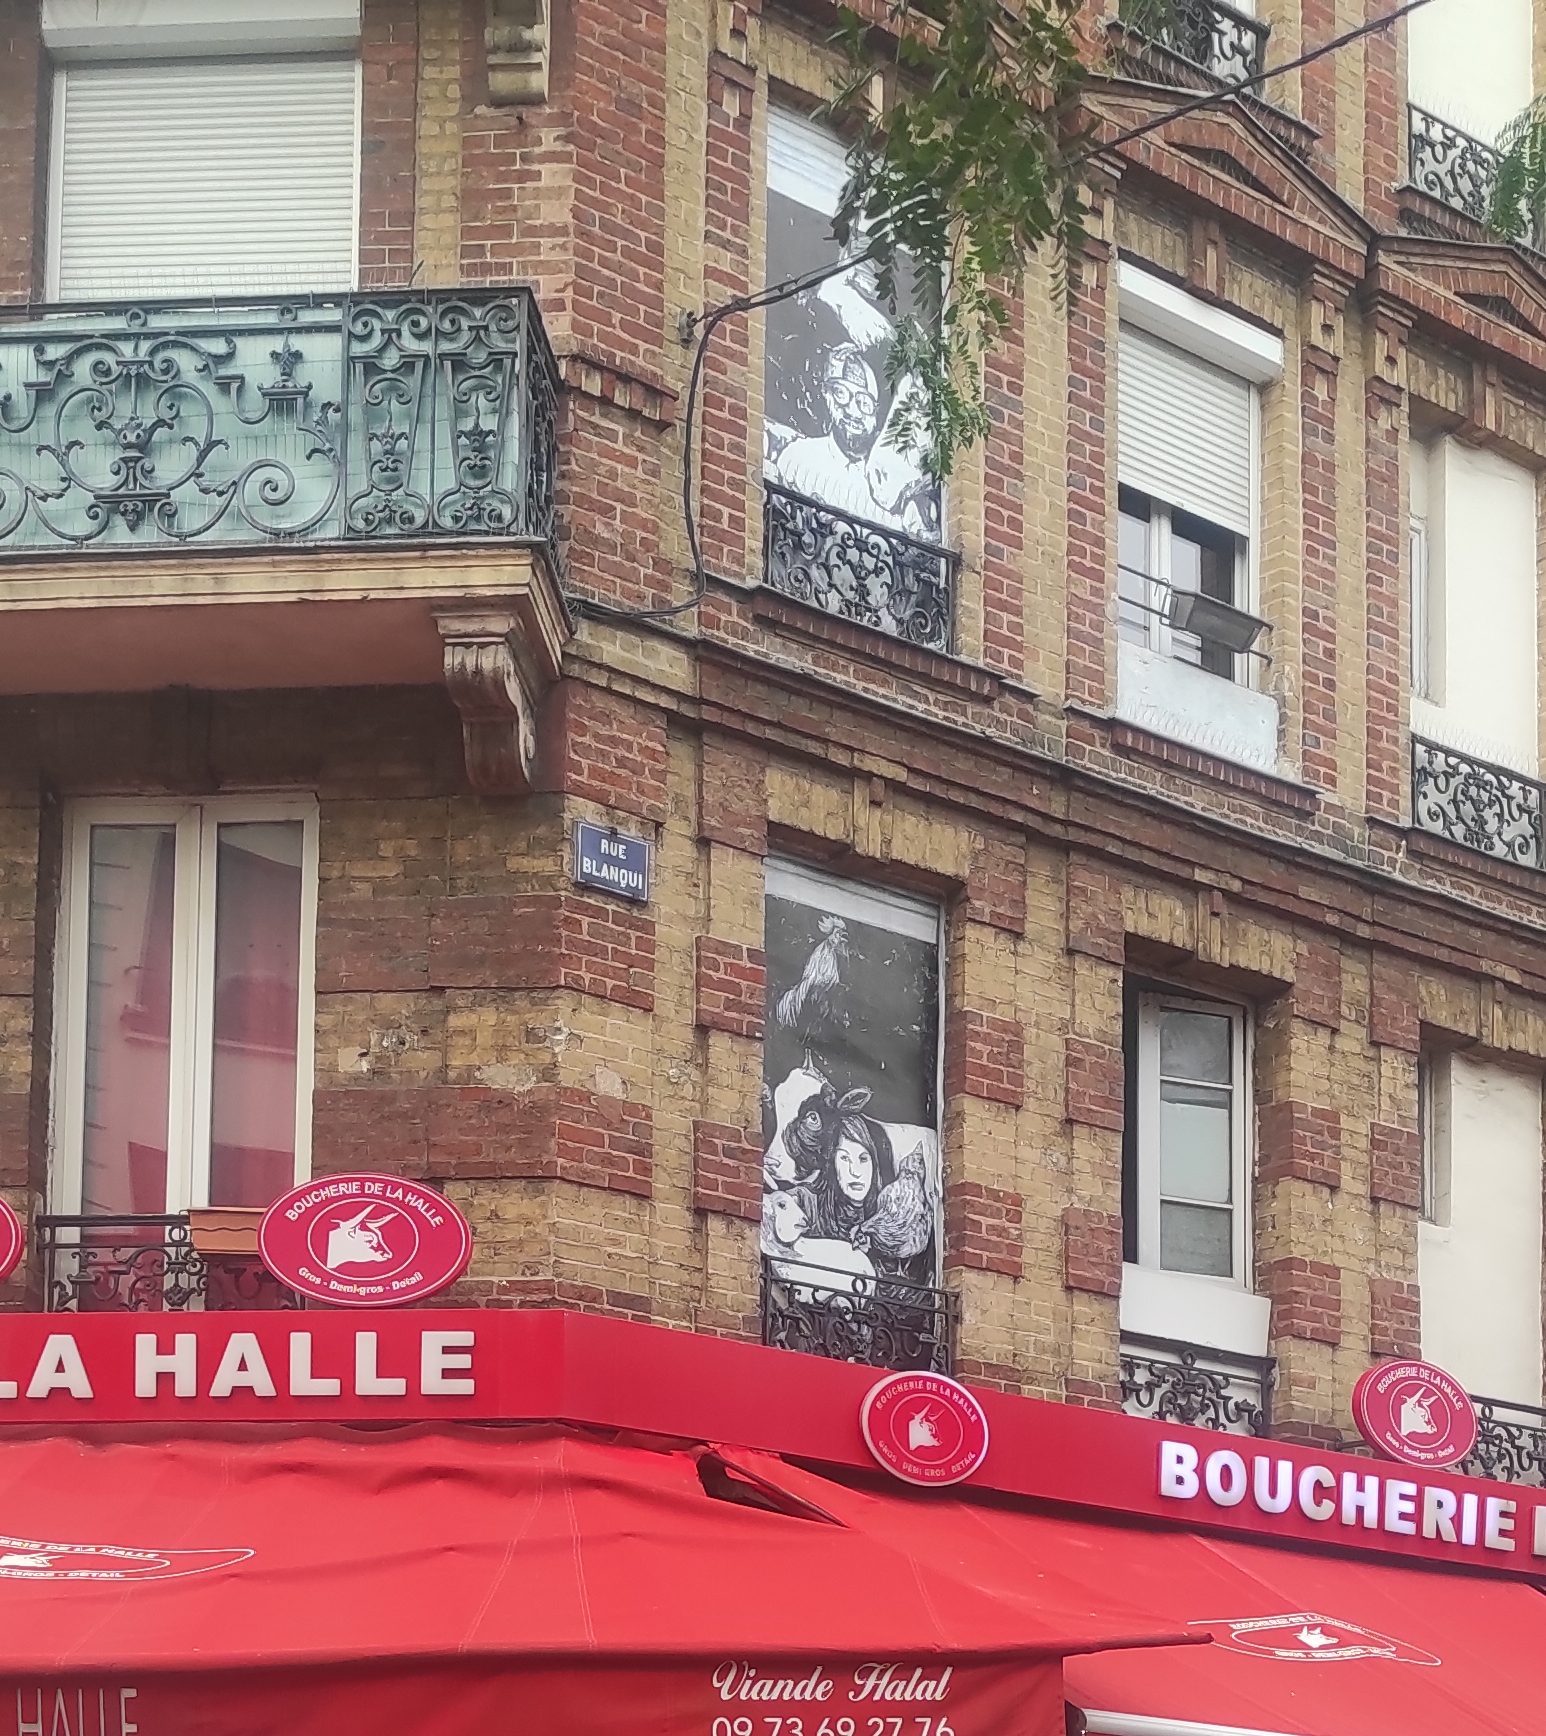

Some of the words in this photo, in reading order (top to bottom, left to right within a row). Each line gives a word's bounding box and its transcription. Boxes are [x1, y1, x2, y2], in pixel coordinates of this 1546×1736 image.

[600, 838, 627, 860] RUE
[582, 855, 643, 890] BLANQUI
[284, 1181, 362, 1222] BOUCHERIE
[364, 1182, 383, 1196] DE
[385, 1185, 404, 1202] LA
[404, 1192, 446, 1230] HALLE
[298, 1267, 322, 1285] Gros
[134, 1330, 477, 1399] HALLE
[876, 1379, 924, 1411] BOUCHERIE
[926, 1381, 937, 1392] DE
[939, 1386, 951, 1397] LA
[952, 1392, 978, 1425] HALLE
[1376, 1366, 1418, 1394] BOUCHERIE
[1419, 1368, 1430, 1381] DE
[1430, 1372, 1441, 1388] LA
[1440, 1380, 1464, 1411] HALLE
[1158, 1440, 1517, 1552] BOUCHERIE
[98, 1547, 160, 1559] HALLE
[712, 1660, 834, 1702] Viande
[848, 1661, 953, 1702] Halal
